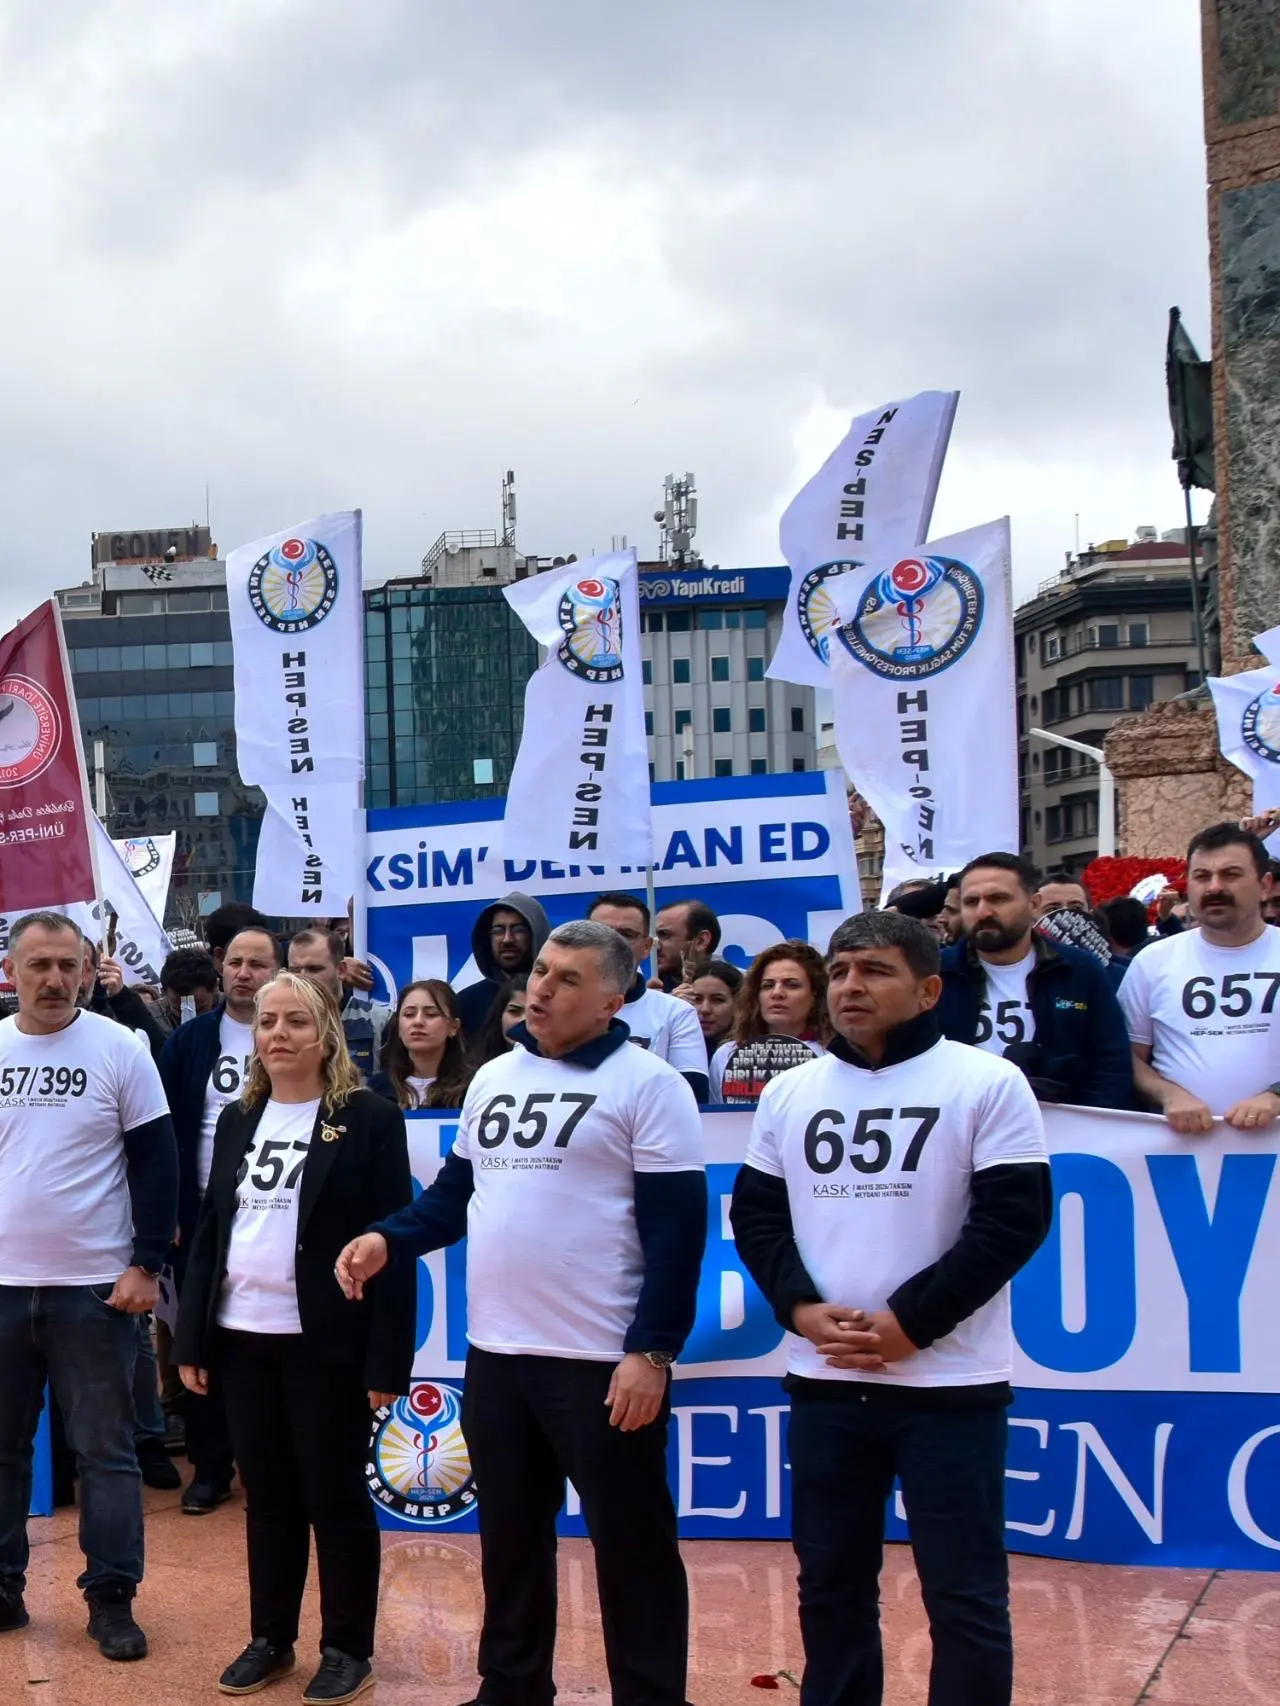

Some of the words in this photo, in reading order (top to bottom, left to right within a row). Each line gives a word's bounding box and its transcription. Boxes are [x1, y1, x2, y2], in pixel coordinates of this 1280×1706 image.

[836, 408, 898, 541] HEP-SEN
[671, 576, 745, 597] YapıKredi
[1181, 972, 1280, 1019] 657
[478, 1093, 597, 1149] 657
[804, 1107, 940, 1174] 657
[480, 1158, 508, 1169] KASK
[813, 1184, 849, 1197] KASK
[404, 1503, 451, 1517] HEP
